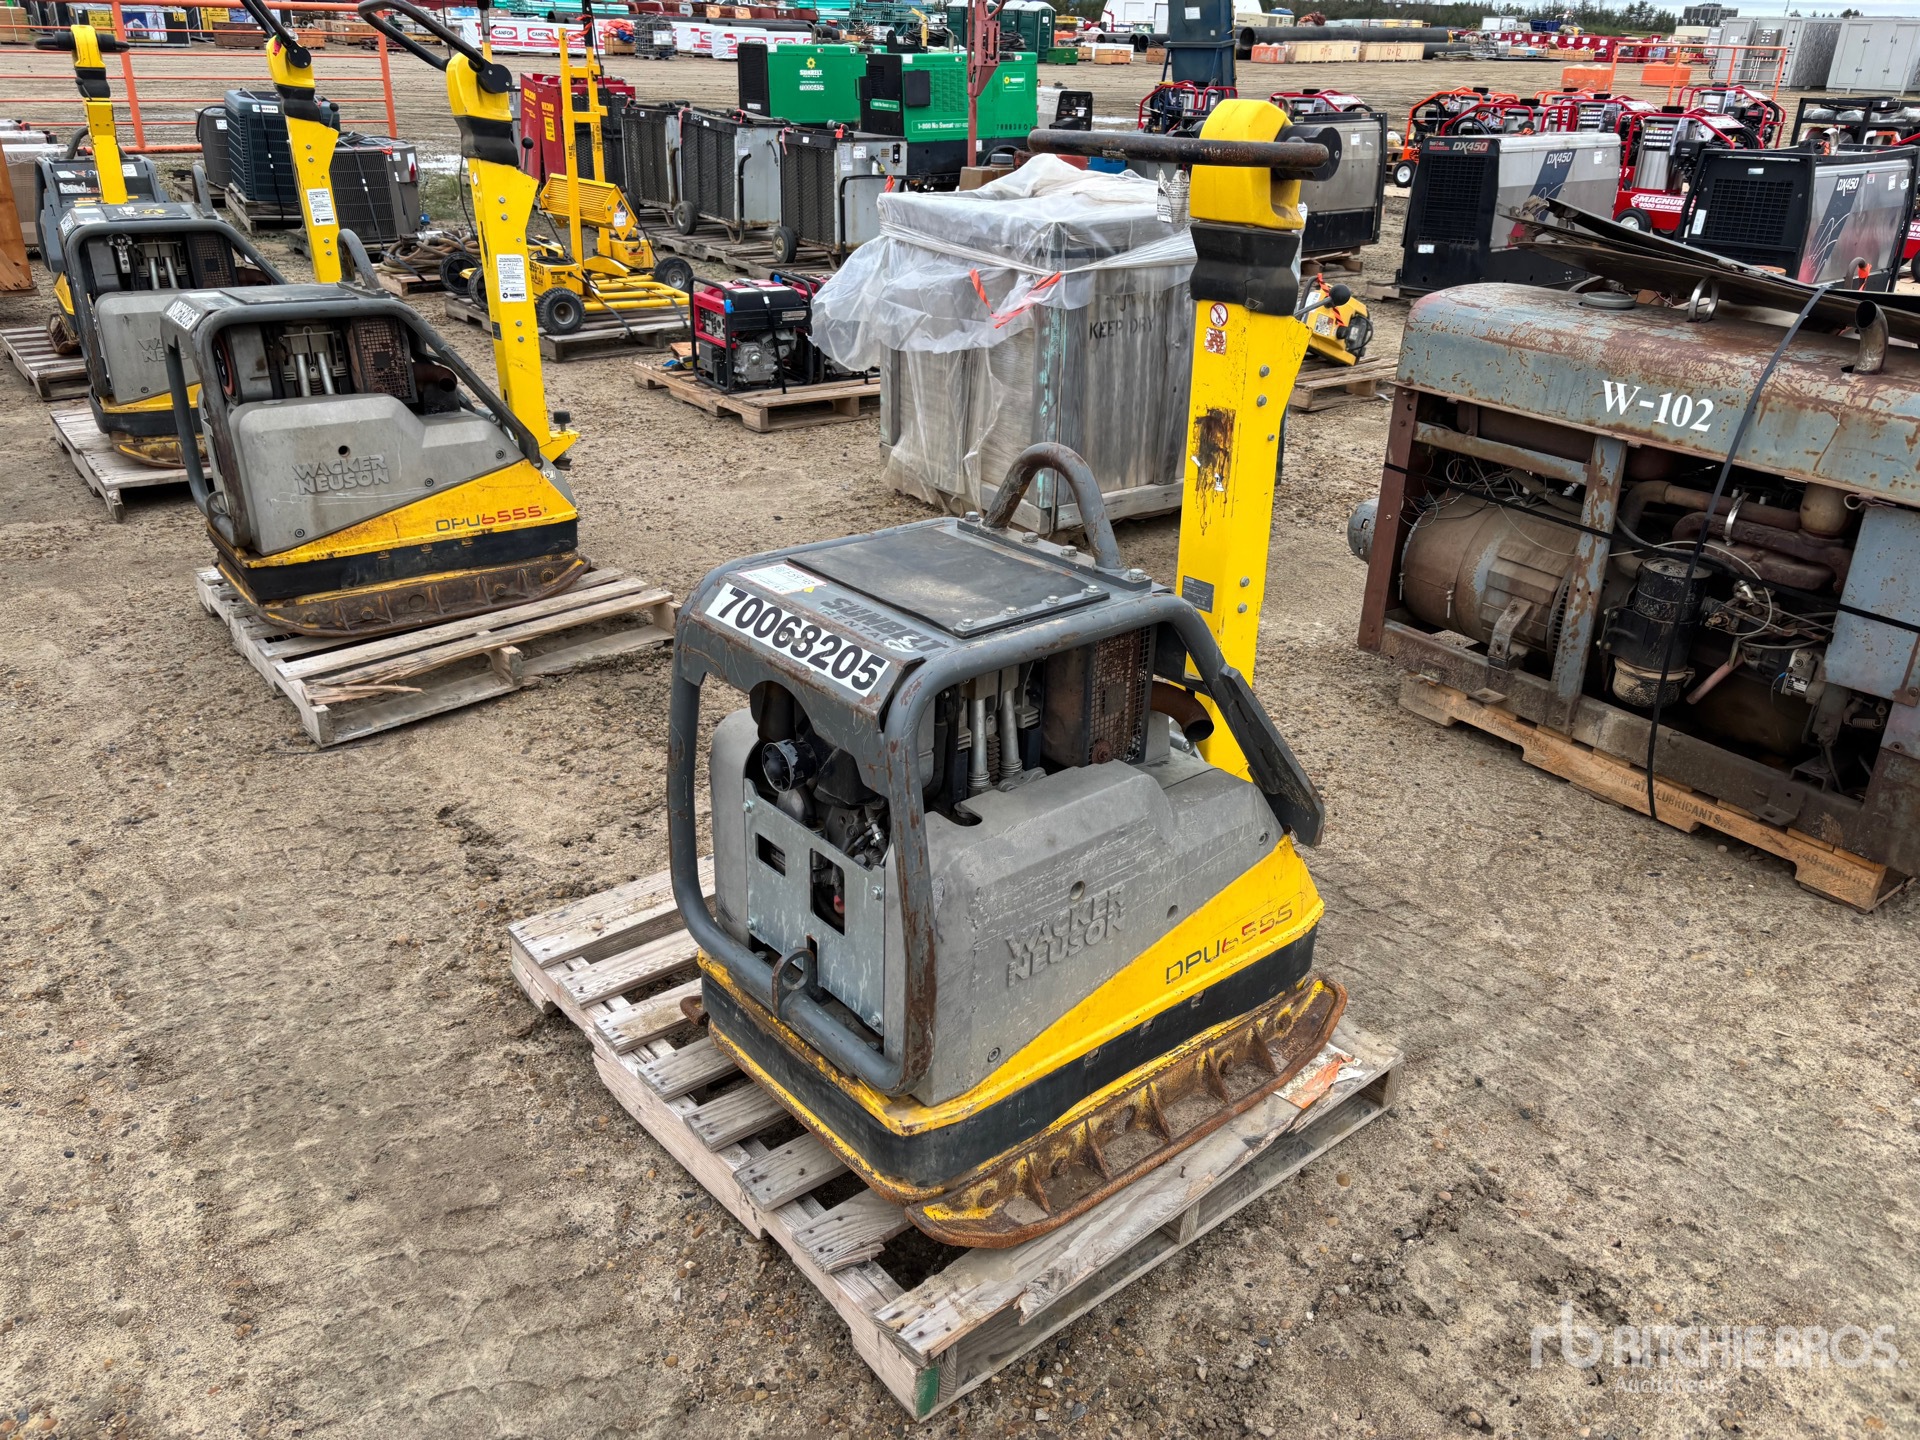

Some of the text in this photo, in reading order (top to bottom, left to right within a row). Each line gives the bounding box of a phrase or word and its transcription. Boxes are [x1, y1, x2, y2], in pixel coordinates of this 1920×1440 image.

[1452, 141, 1489, 155] DX450
[1546, 152, 1573, 169] DX450
[1836, 177, 1860, 197] DX450
[1089, 316, 1153, 340] KEEP DRY
[1602, 380, 1715, 433] W-102
[292, 454, 388, 480] WACKER
[295, 467, 390, 496] NEUSON
[435, 505, 543, 533] DPU6555
[820, 597, 951, 653] SUNBELT
